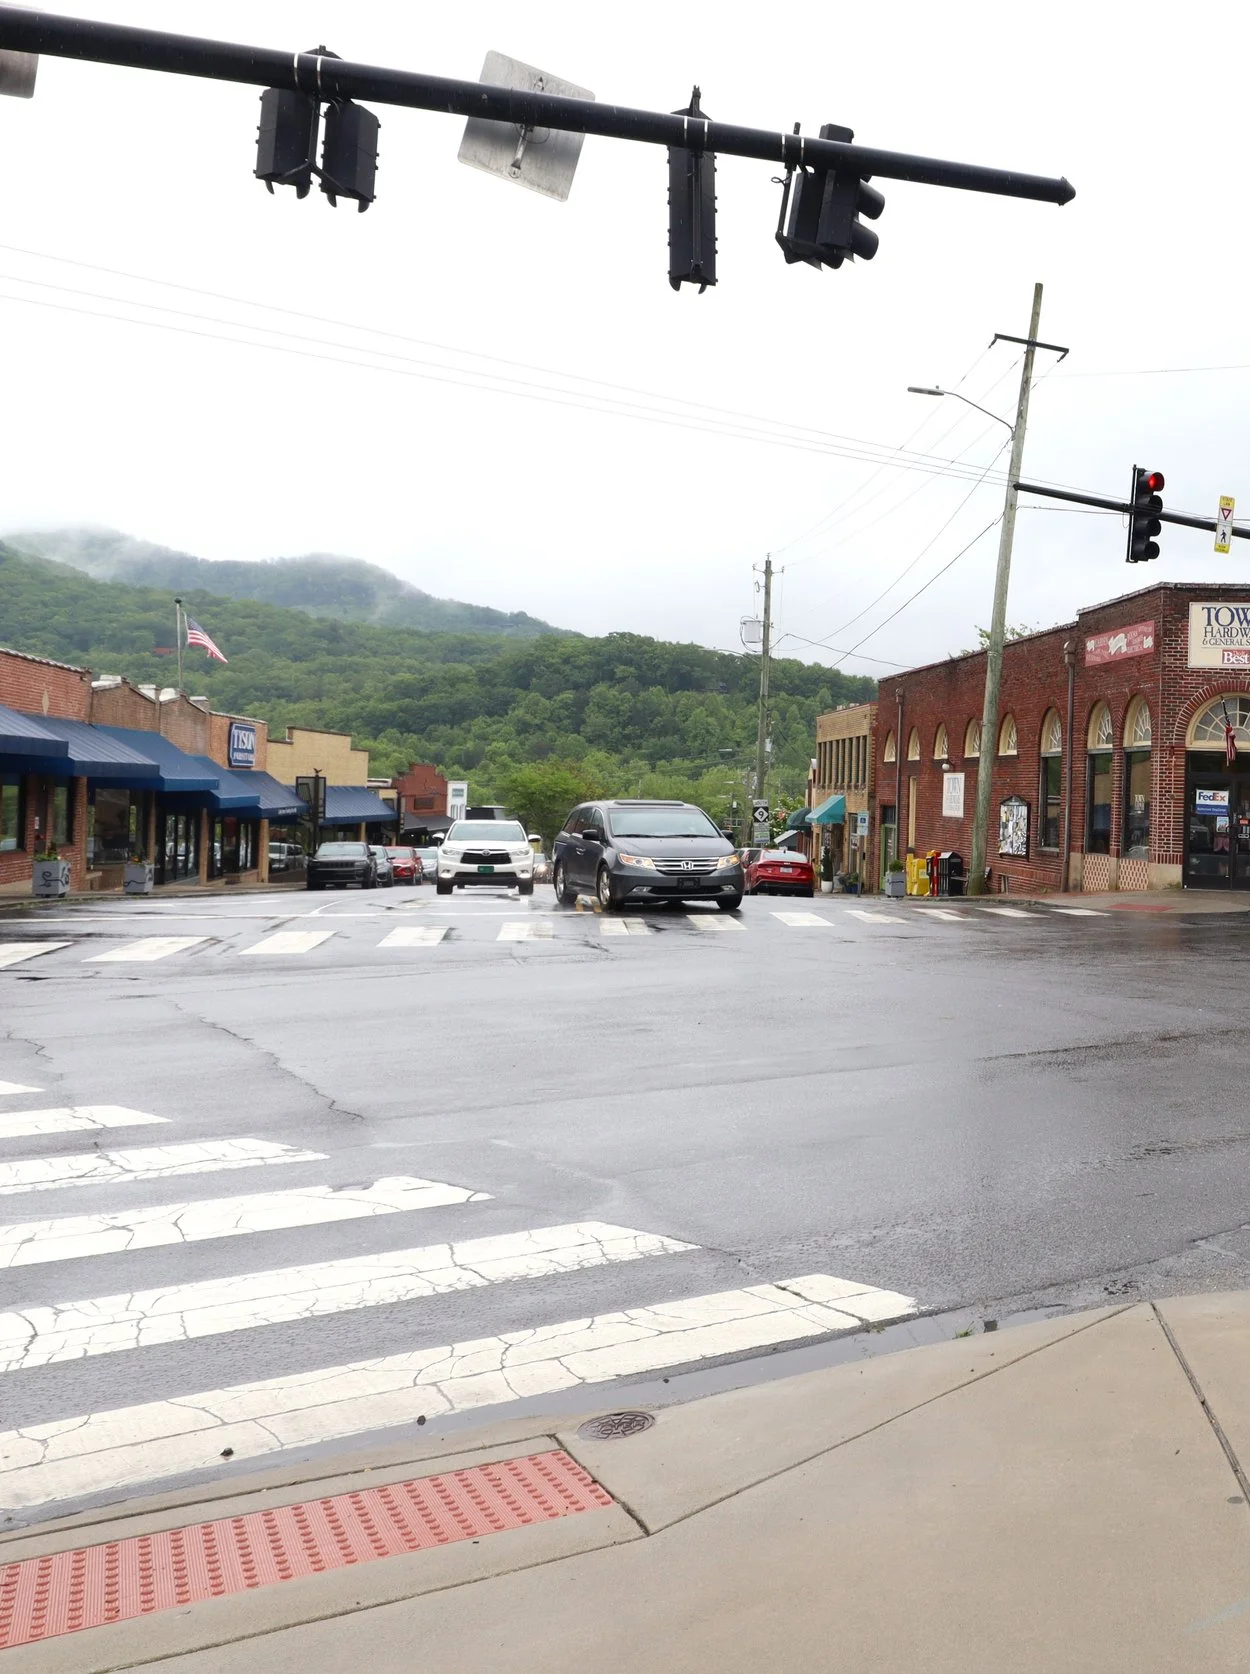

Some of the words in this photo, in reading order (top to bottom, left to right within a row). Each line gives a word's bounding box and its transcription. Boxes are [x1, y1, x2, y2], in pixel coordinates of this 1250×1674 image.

[1202, 637, 1208, 646] &
[1208, 638, 1244, 646] GENERAL
[1223, 651, 1250, 664] Best
[1198, 791, 1226, 802] FedEx
[758, 810, 765, 819] 9
